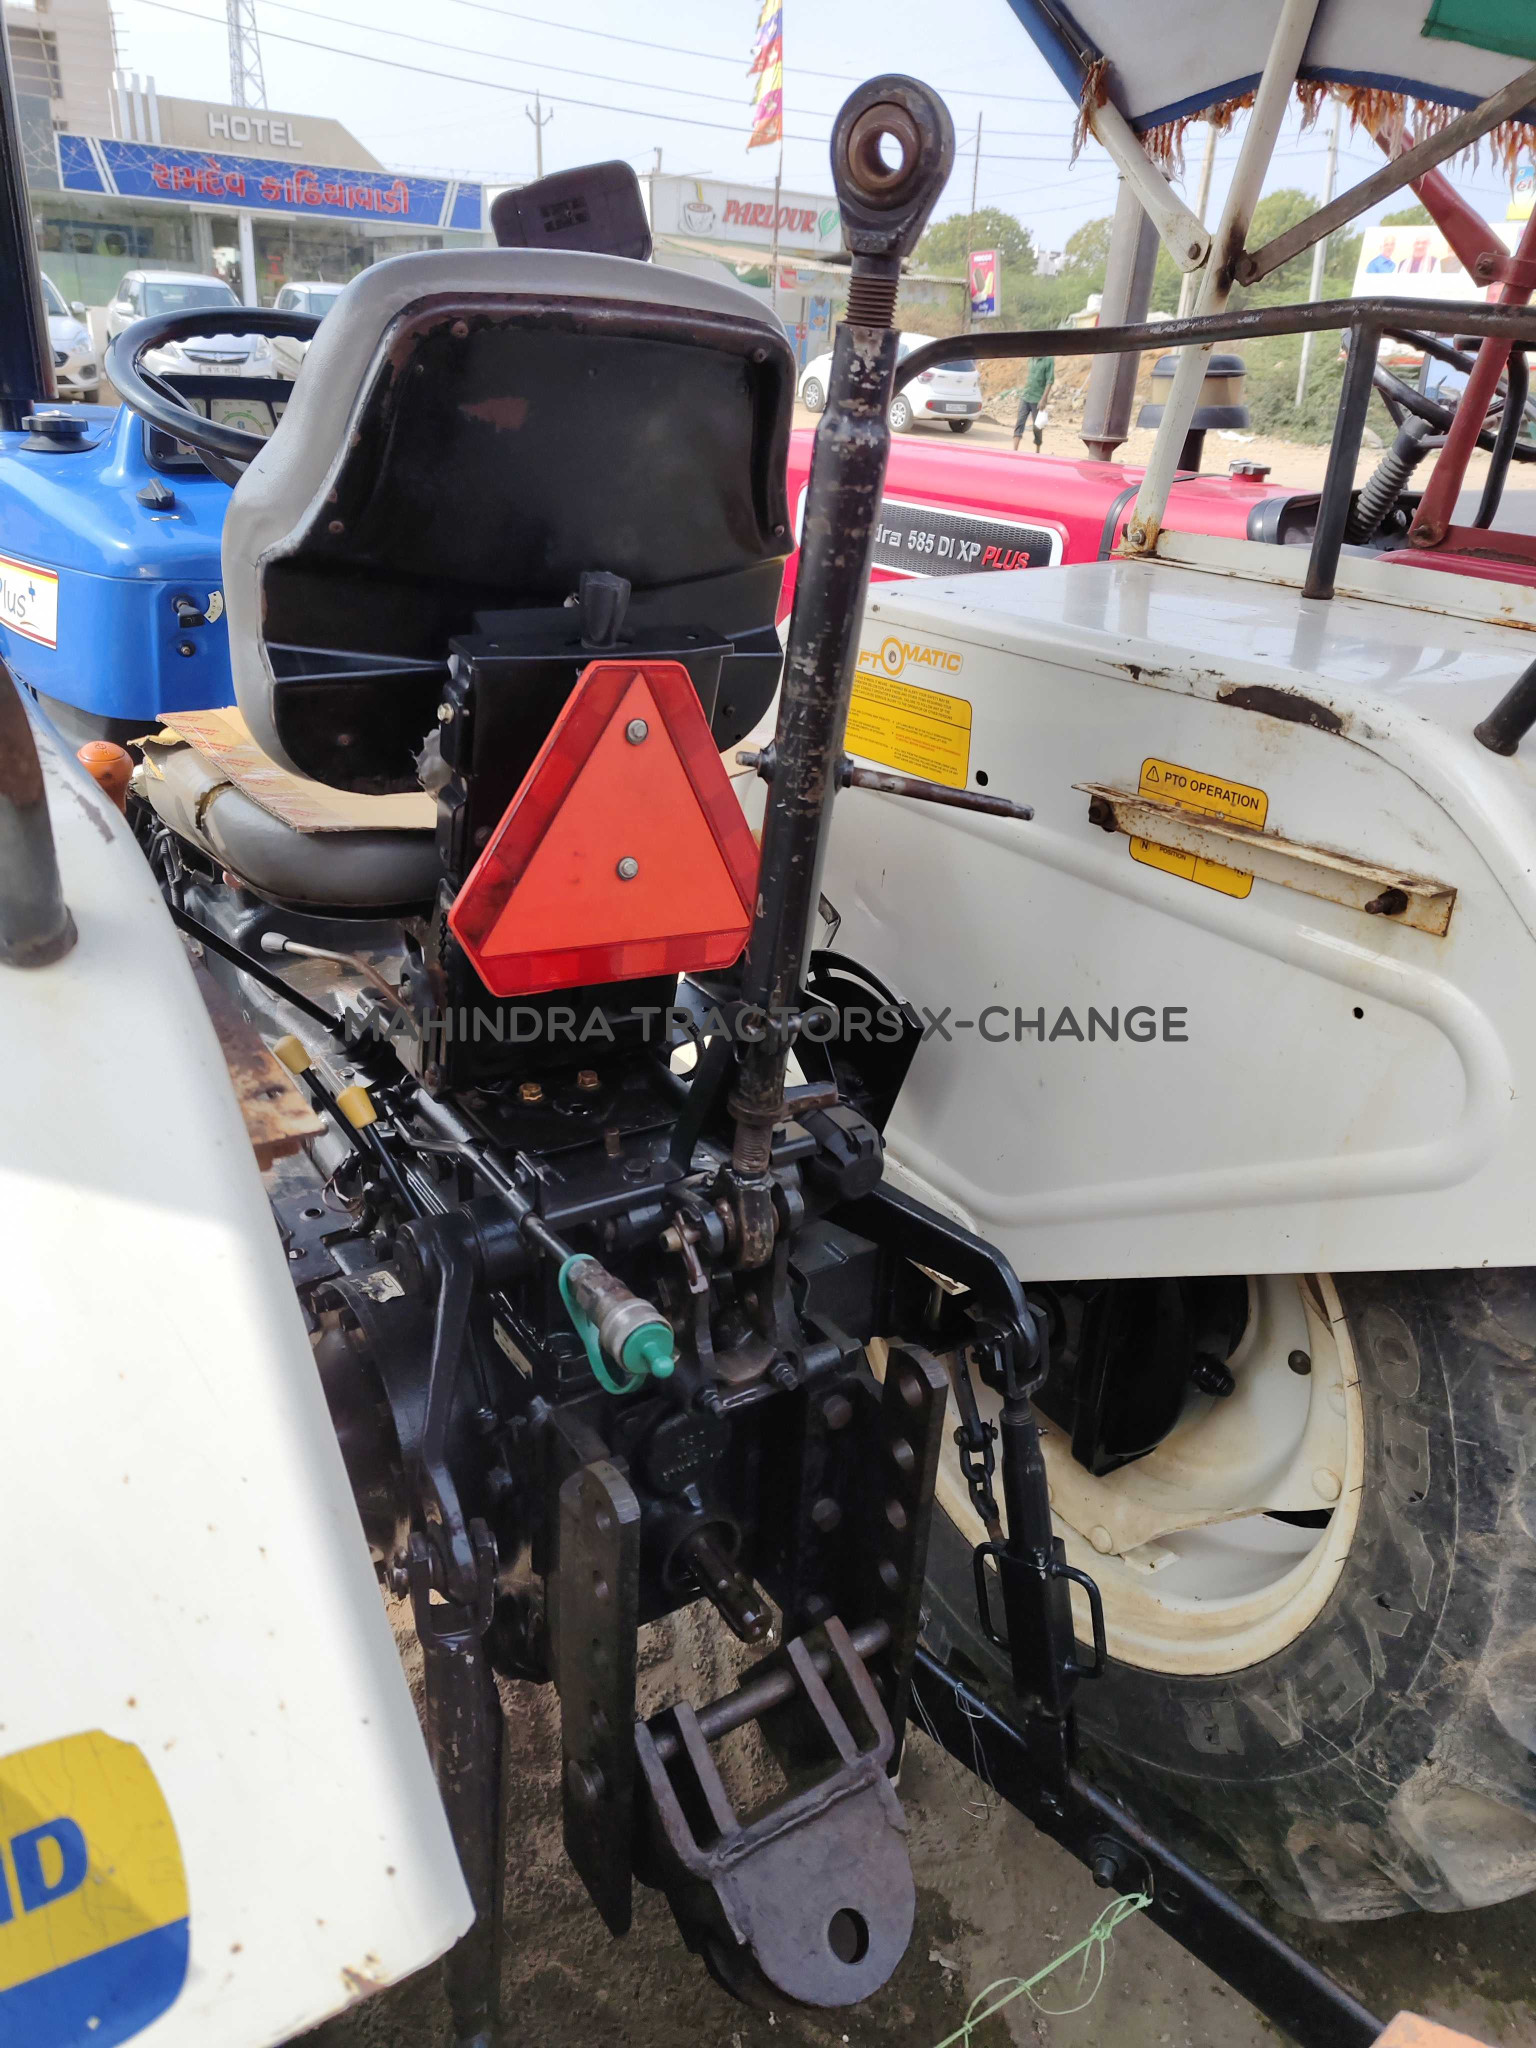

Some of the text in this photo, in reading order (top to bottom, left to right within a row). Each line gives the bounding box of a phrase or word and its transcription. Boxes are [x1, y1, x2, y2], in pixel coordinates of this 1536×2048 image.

[207, 112, 303, 148] HOTEL
[722, 199, 818, 233] PARLOUR
[908, 530, 936, 554] 585
[937, 536, 956, 559] DI
[957, 539, 981, 563] XP
[981, 545, 1030, 570] PLUS
[1164, 772, 1260, 811] PTO OPERATION
